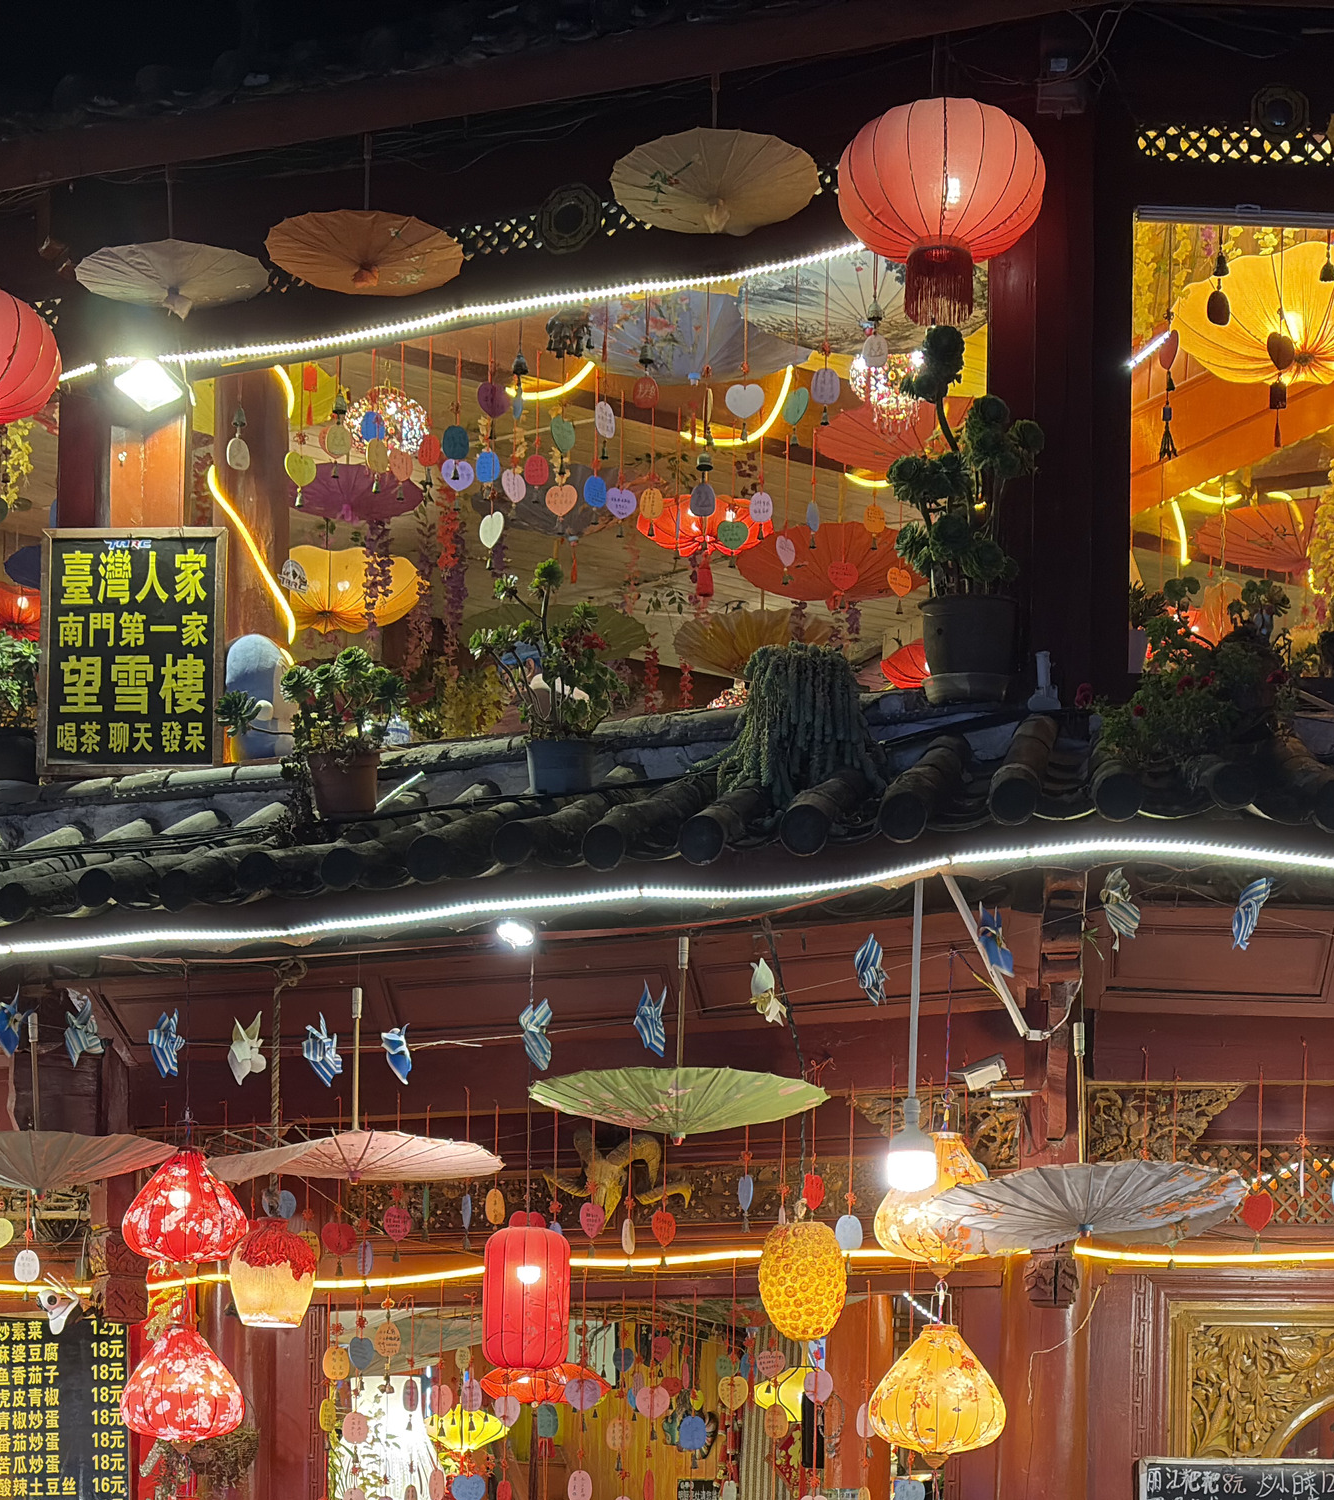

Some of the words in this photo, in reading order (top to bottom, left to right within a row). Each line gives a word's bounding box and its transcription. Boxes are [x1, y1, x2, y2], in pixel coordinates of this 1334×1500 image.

[60, 549, 207, 604] 臺灣人家
[58, 612, 208, 647] 南門第一家
[60, 654, 206, 714] 望雪樓
[57, 722, 101, 753] 喝茶
[108, 722, 153, 753] 聊天
[161, 722, 205, 753] 發呆
[91, 1340, 124, 1358] 18元
[91, 1363, 125, 1381] 18元
[91, 1386, 125, 1403] 18元
[91, 1408, 125, 1426] 18元
[92, 1431, 125, 1448] 18元
[92, 1454, 125, 1471] 18元
[92, 1476, 125, 1494] 16元
